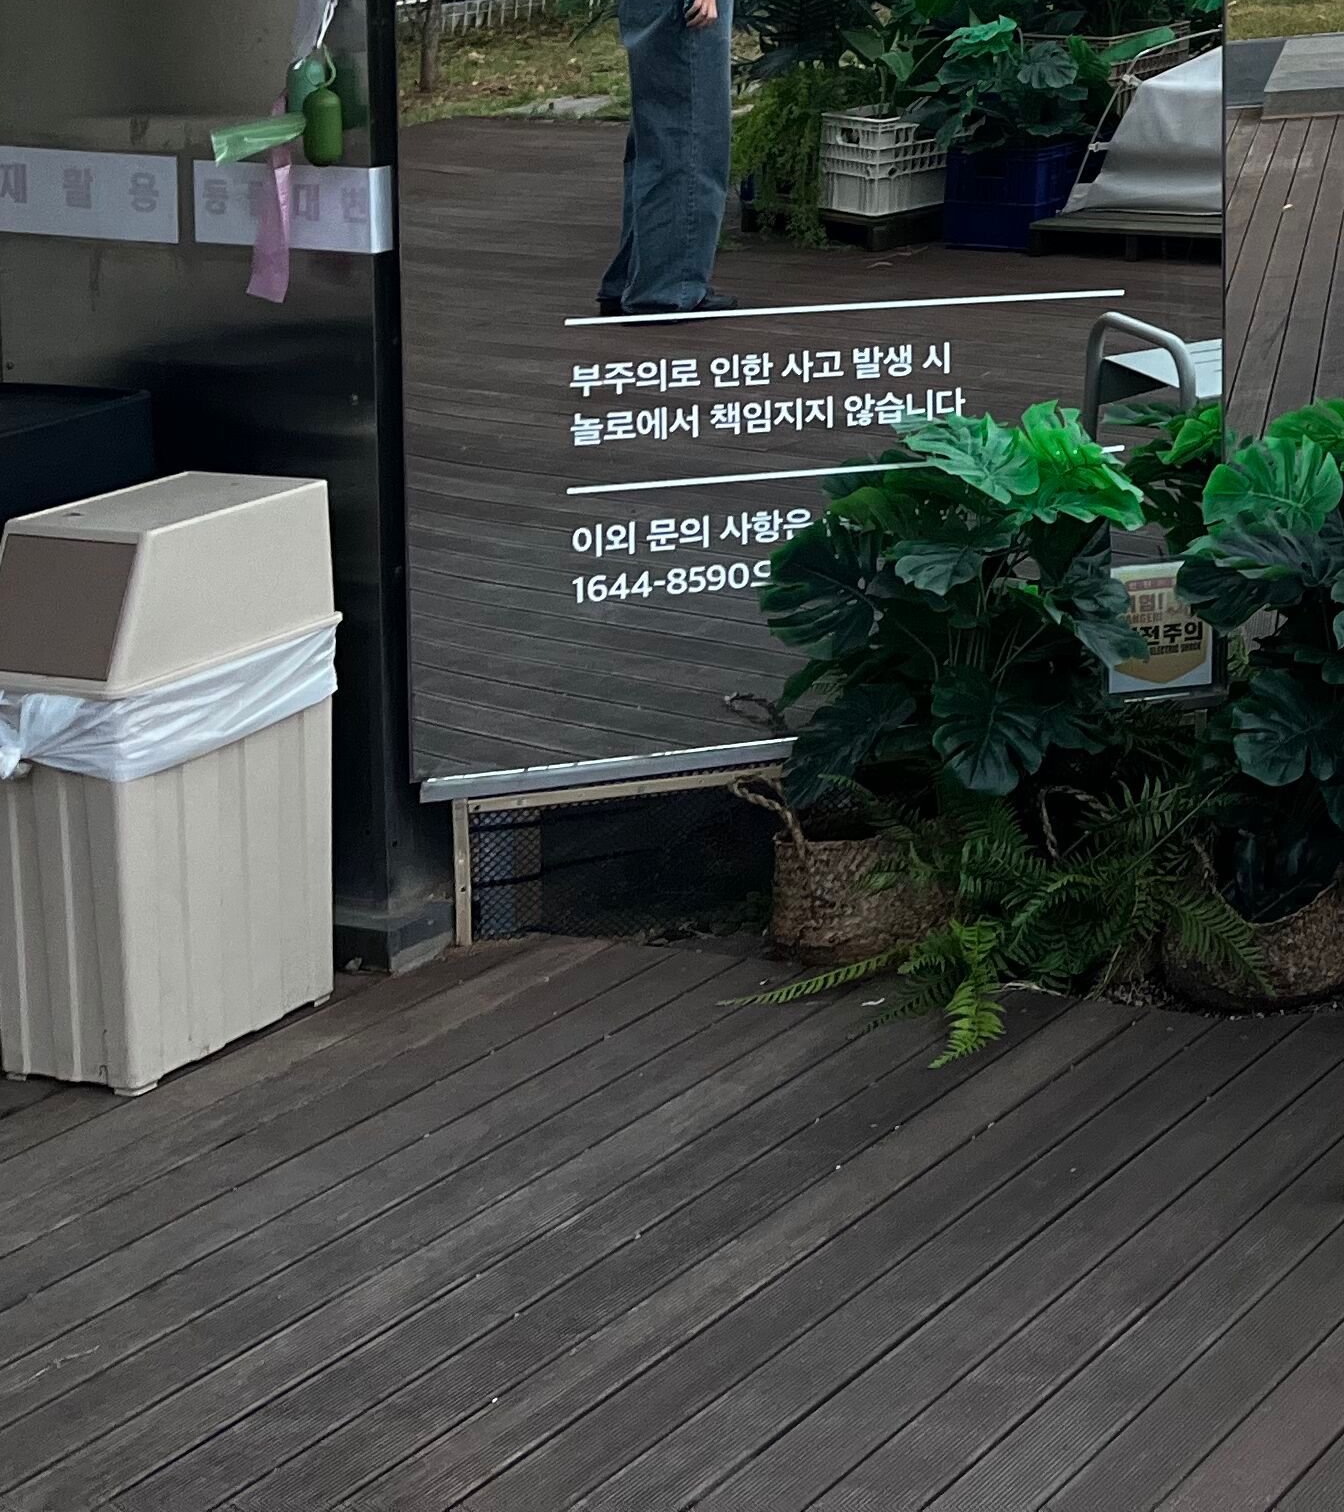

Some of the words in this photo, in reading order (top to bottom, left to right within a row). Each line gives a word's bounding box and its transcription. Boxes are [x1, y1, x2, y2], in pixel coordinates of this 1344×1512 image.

[570, 358, 700, 396] 부주의로
[710, 352, 773, 388] 인한
[781, 349, 844, 383] 사고
[852, 344, 914, 380] 발생
[922, 342, 951, 374] 시
[570, 405, 700, 447] 놀로에서
[710, 395, 833, 435] 책임지지
[844, 388, 966, 426] 않습니다
[572, 521, 636, 557] 이외
[646, 515, 710, 552] 문의
[720, 508, 814, 545] 사항은
[1132, 621, 1203, 646] 전주의
